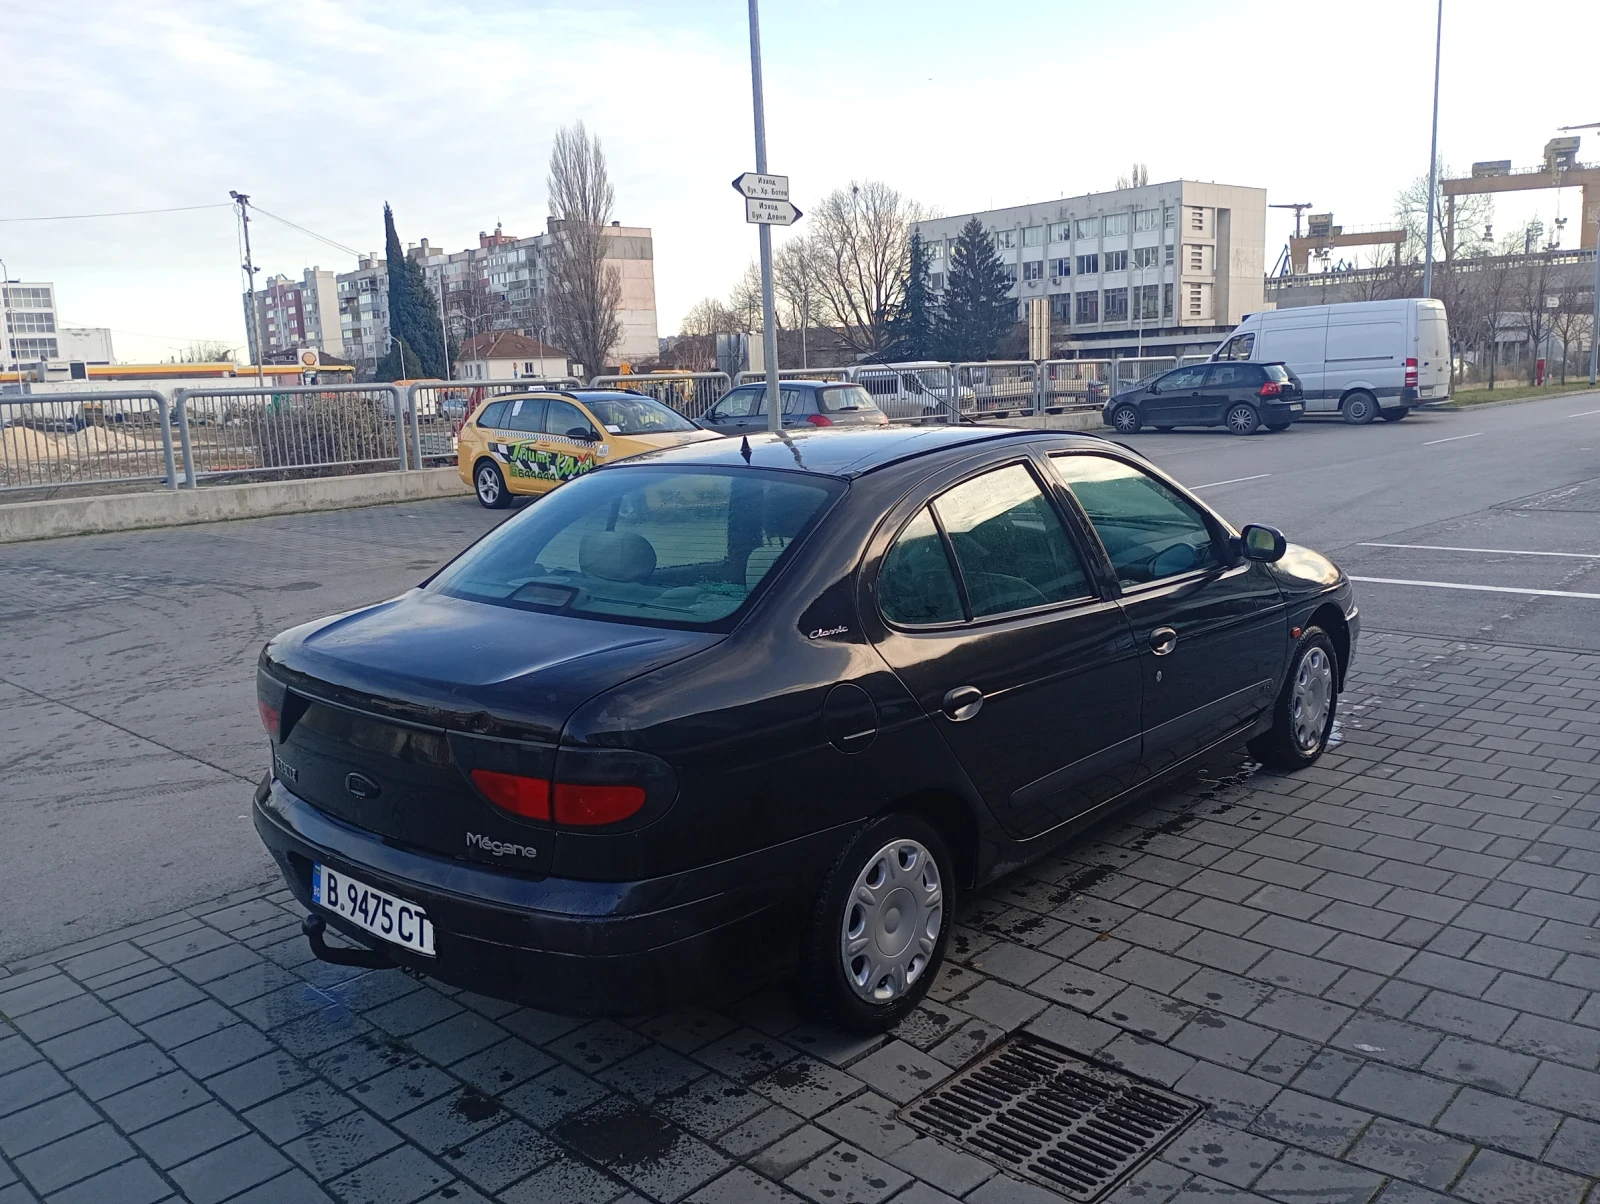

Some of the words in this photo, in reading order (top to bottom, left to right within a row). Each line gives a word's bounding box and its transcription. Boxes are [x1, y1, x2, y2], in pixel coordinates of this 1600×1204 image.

[757, 177, 776, 186] Изход
[771, 188, 788, 196] Ботев
[758, 202, 778, 211] Изход
[767, 212, 787, 221] Девня
[809, 625, 849, 639] Classic
[466, 831, 537, 858] Mégane
